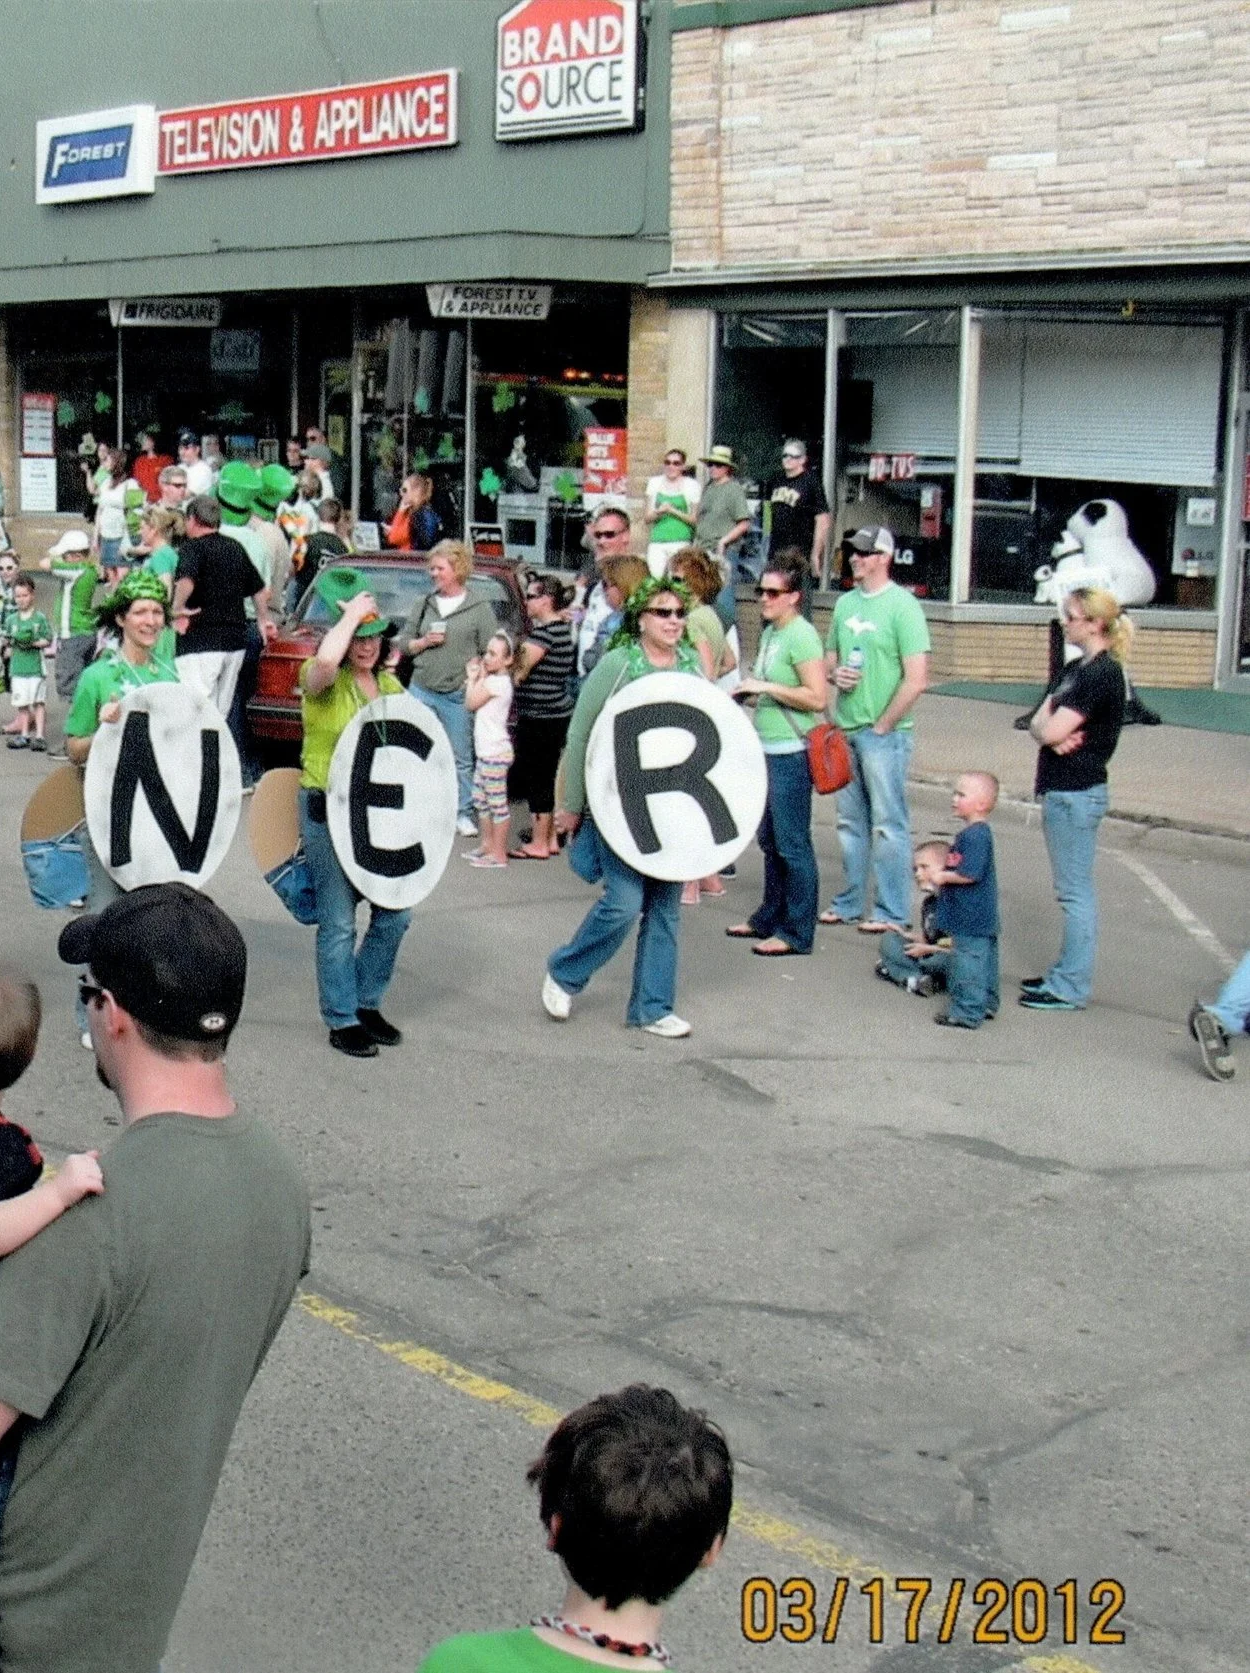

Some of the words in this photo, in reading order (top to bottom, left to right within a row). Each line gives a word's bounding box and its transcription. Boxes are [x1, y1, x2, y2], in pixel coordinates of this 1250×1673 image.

[503, 14, 622, 67] BRAND
[500, 60, 622, 114] SOURCE
[162, 109, 281, 165] TELEVISION
[289, 105, 305, 151] &
[315, 84, 446, 148] APPLIANCE
[453, 286, 513, 300] FOREST
[139, 303, 215, 321] FRIGIDAIRE
[444, 300, 454, 313] &
[459, 301, 543, 316] APPLIANCE
[894, 549, 914, 565] LG
